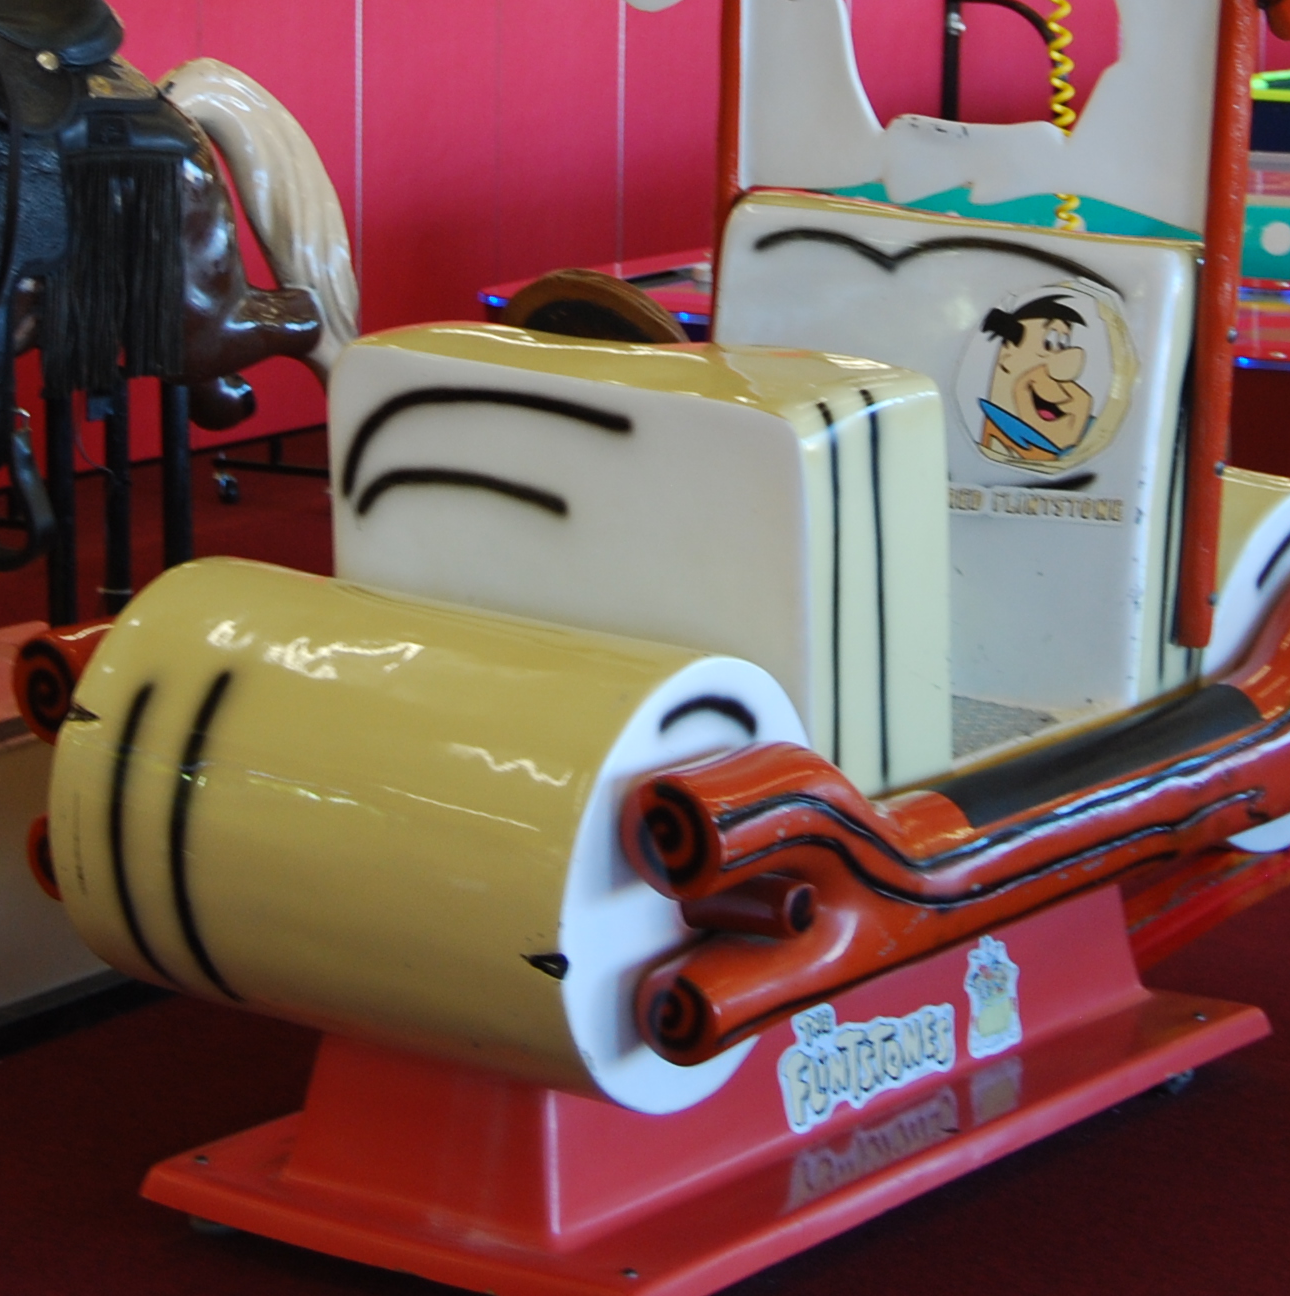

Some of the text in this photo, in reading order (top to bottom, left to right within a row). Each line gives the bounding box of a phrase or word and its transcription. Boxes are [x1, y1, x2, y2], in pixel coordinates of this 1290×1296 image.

[992, 490, 1124, 522] FLINTSTONE
[797, 1007, 831, 1048] THE
[782, 1010, 951, 1127] FLINTSTONES
